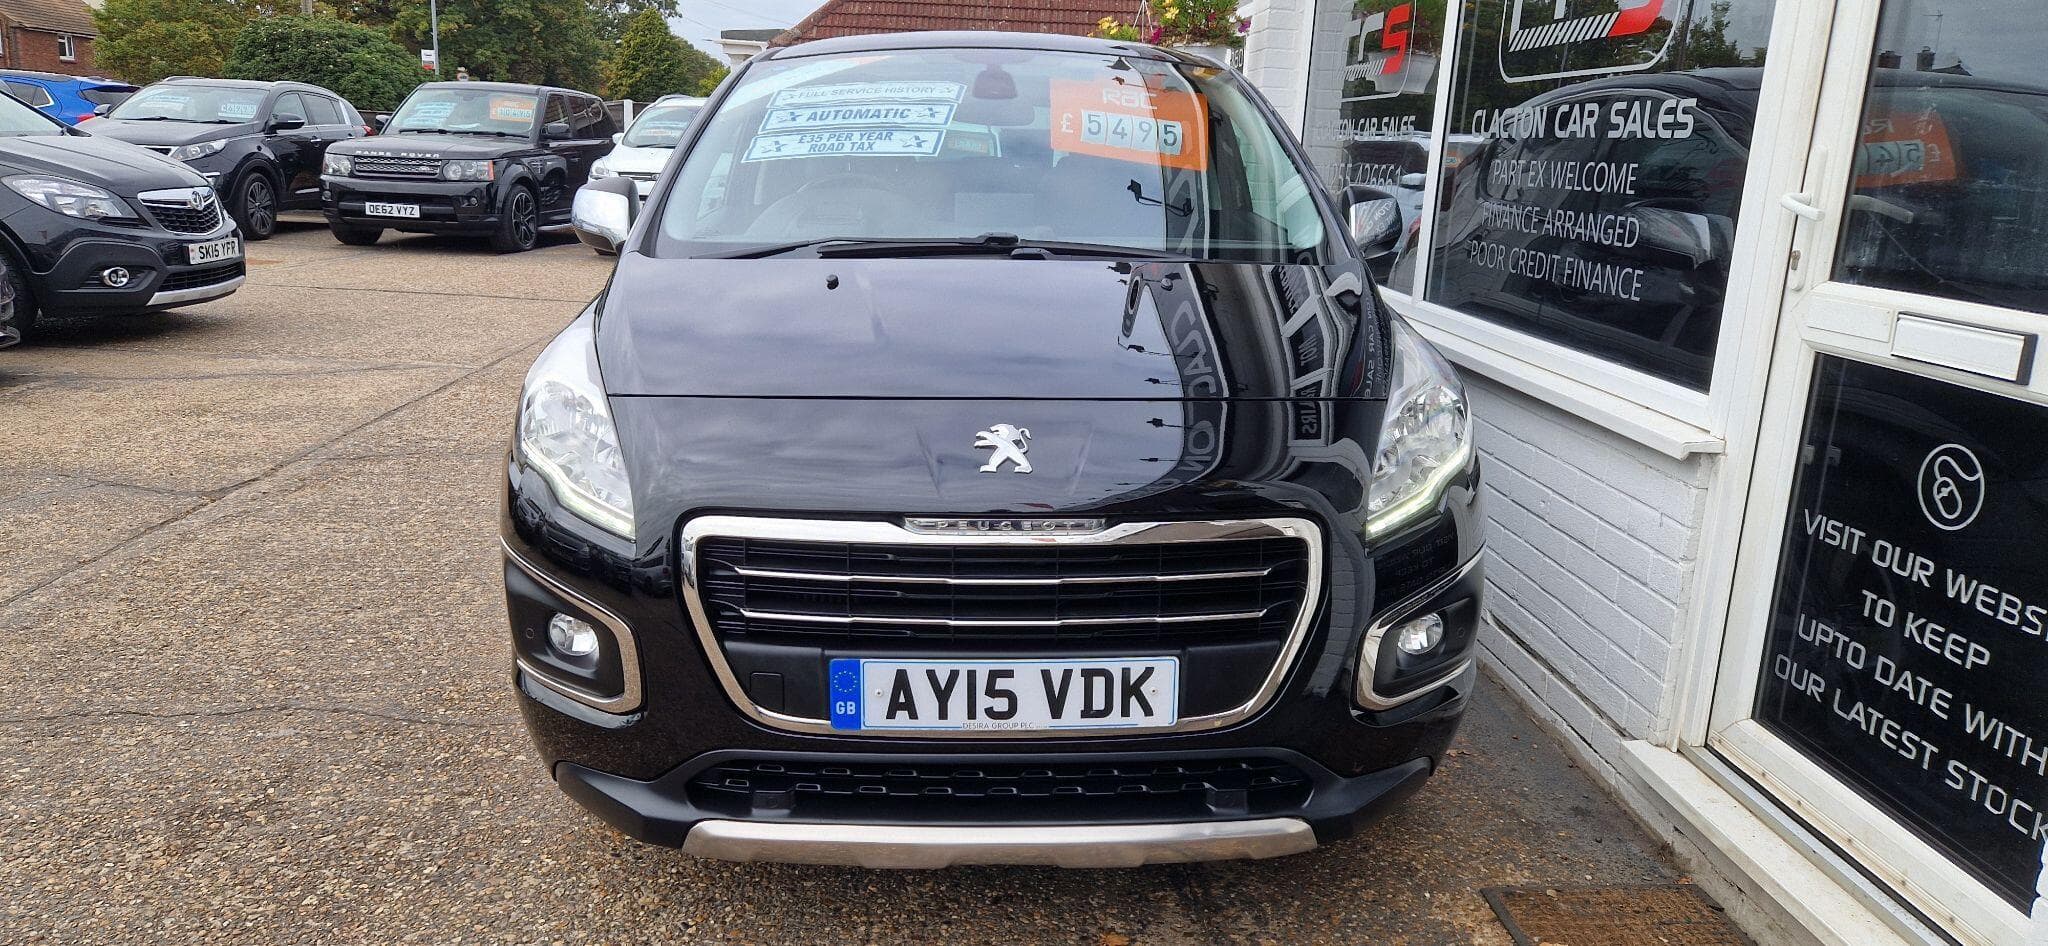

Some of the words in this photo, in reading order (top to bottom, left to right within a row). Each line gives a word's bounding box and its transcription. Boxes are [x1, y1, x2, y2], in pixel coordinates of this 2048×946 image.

[798, 91, 828, 99] FULL
[832, 86, 882, 96] SERVICE
[885, 86, 936, 94] HISTORY
[806, 108, 912, 122] AUTOMATIC
[1358, 117, 1378, 138] CAR
[1382, 115, 1416, 138] SALES
[1471, 106, 1548, 139] CLACTON
[1554, 102, 1600, 139] CAR
[1607, 97, 1698, 139] SALES
[797, 133, 823, 144] £35
[827, 133, 854, 143] PER
[858, 131, 893, 142] YEAR
[1060, 114, 1074, 134] £
[1086, 113, 1179, 148] 5495
[808, 142, 845, 153] ROAD
[850, 141, 875, 152] TAX
[1491, 159, 1527, 185] PART
[1528, 160, 1547, 188] EX
[1550, 161, 1639, 195] WELCOME
[368, 204, 394, 215] OE62
[396, 205, 415, 216] VYZ
[1481, 201, 1541, 235] FINANCE
[1542, 208, 1640, 248] ARRANGED
[198, 243, 220, 260] SK15
[221, 240, 236, 256] YFR
[1469, 239, 1506, 271] POOR
[1508, 247, 1561, 283] CREDIT
[1563, 256, 1644, 302] FINANCE
[935, 520, 1076, 531] PEUGEOT
[1804, 508, 1867, 557] VISIT
[1871, 540, 1936, 589] OUR
[1861, 589, 1896, 629] TO
[1904, 611, 1992, 670] KEEP
[835, 700, 857, 716] GB
[885, 668, 1018, 721] AY15
[1040, 666, 1156, 720] VDK
[1798, 613, 1867, 671] UPTO
[1874, 655, 1954, 721] DATE
[1963, 703, 2048, 777] WITH
[962, 722, 990, 730] DESIRA
[991, 722, 1019, 730] GROUP
[1020, 721, 1035, 729] PLC
[1774, 653, 1826, 703] OUR
[1833, 687, 1939, 771] LATEST
[1944, 759, 2048, 842] STOCK
